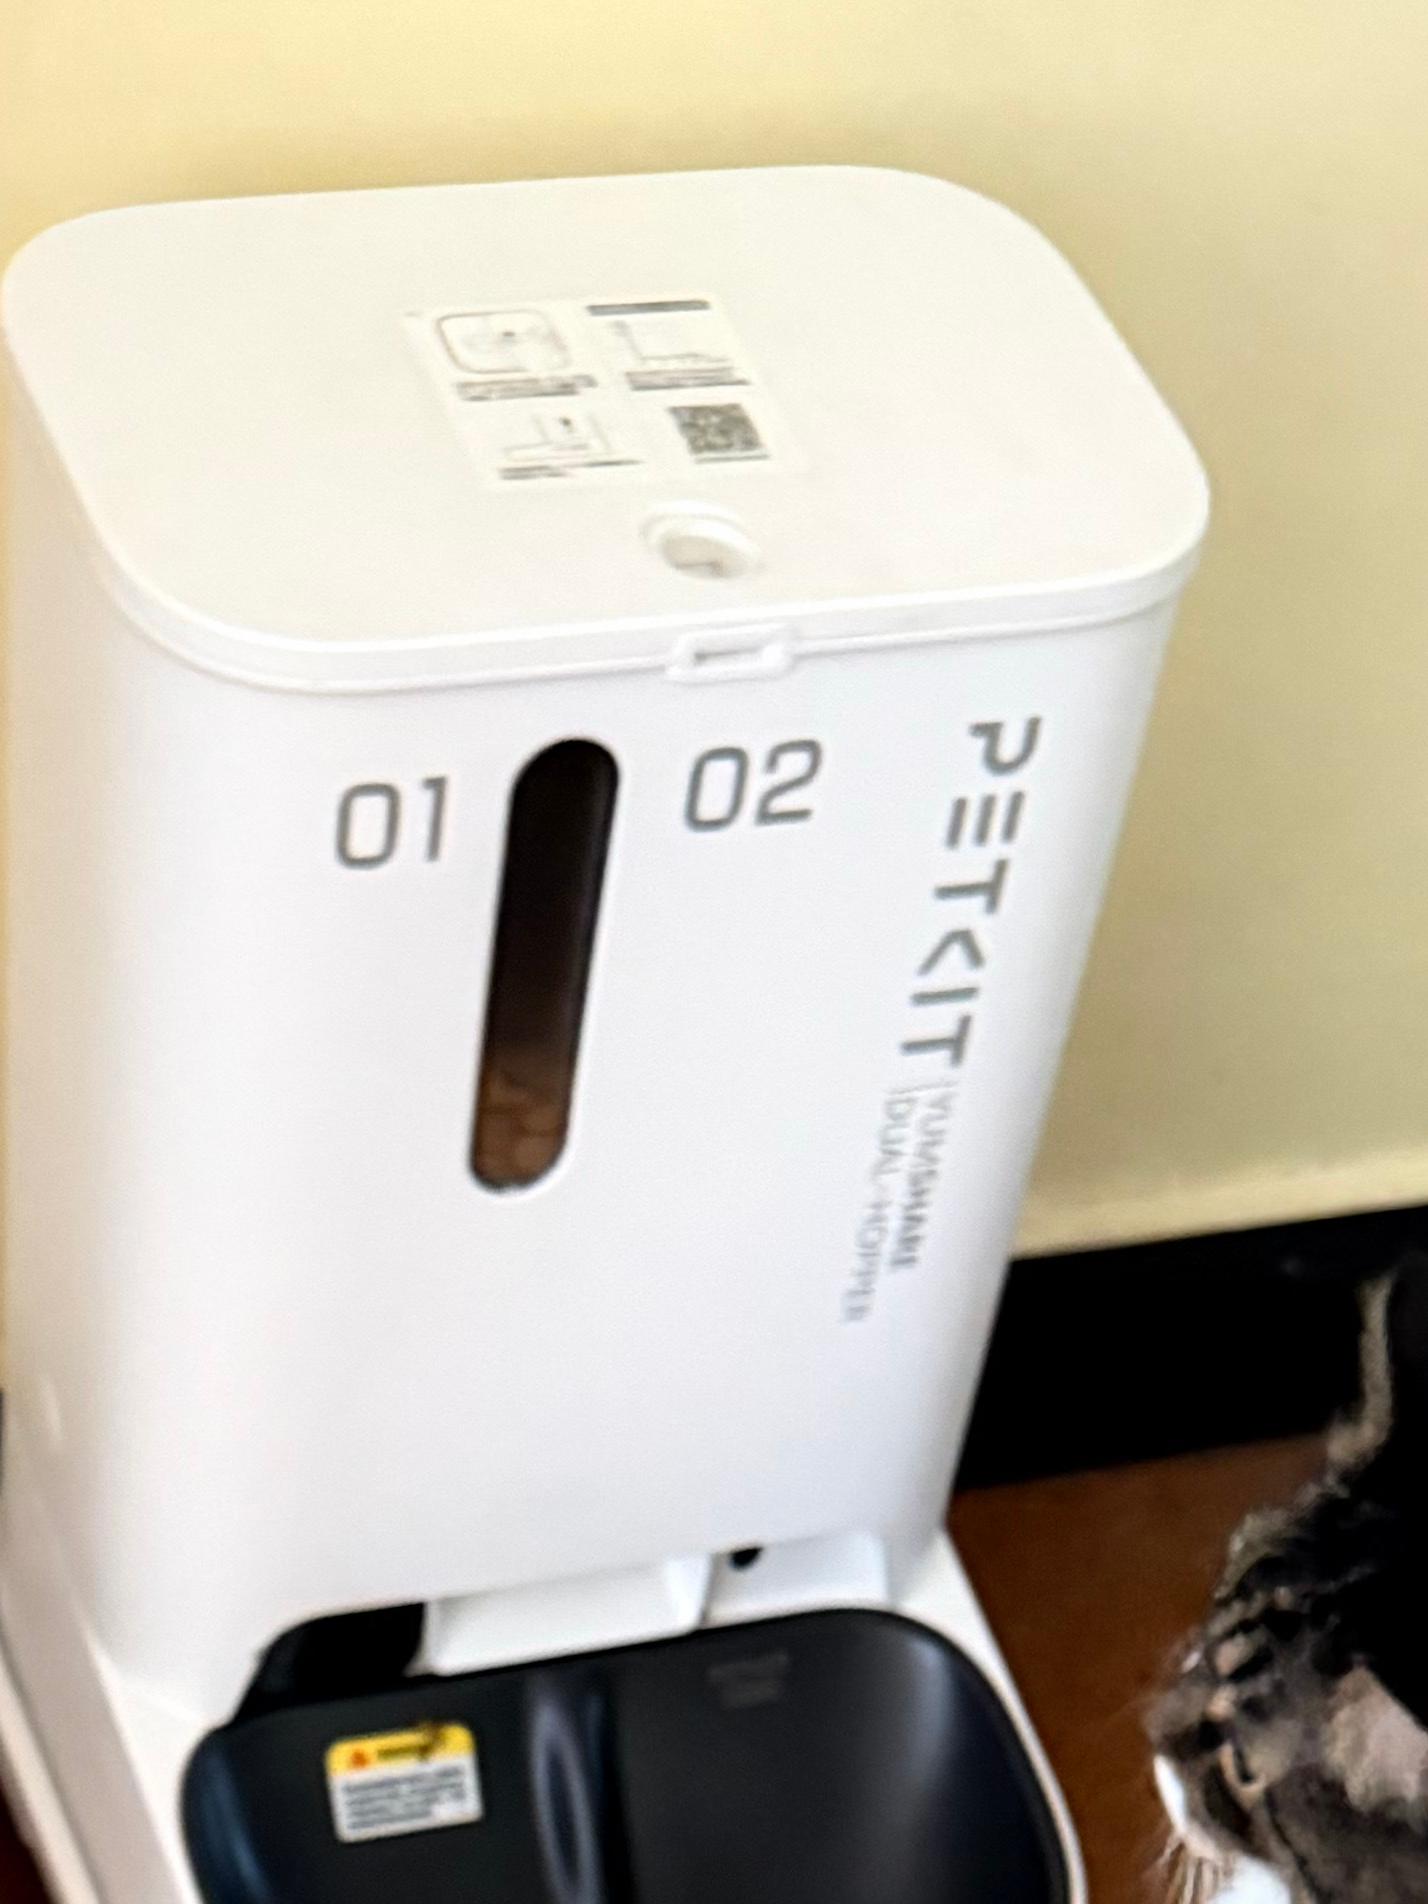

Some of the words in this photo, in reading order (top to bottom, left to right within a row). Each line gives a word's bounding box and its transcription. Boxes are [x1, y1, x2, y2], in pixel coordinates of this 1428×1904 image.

[335, 775, 449, 870] 01
[684, 739, 822, 832] 02
[900, 716, 1042, 1067] PETKIT
